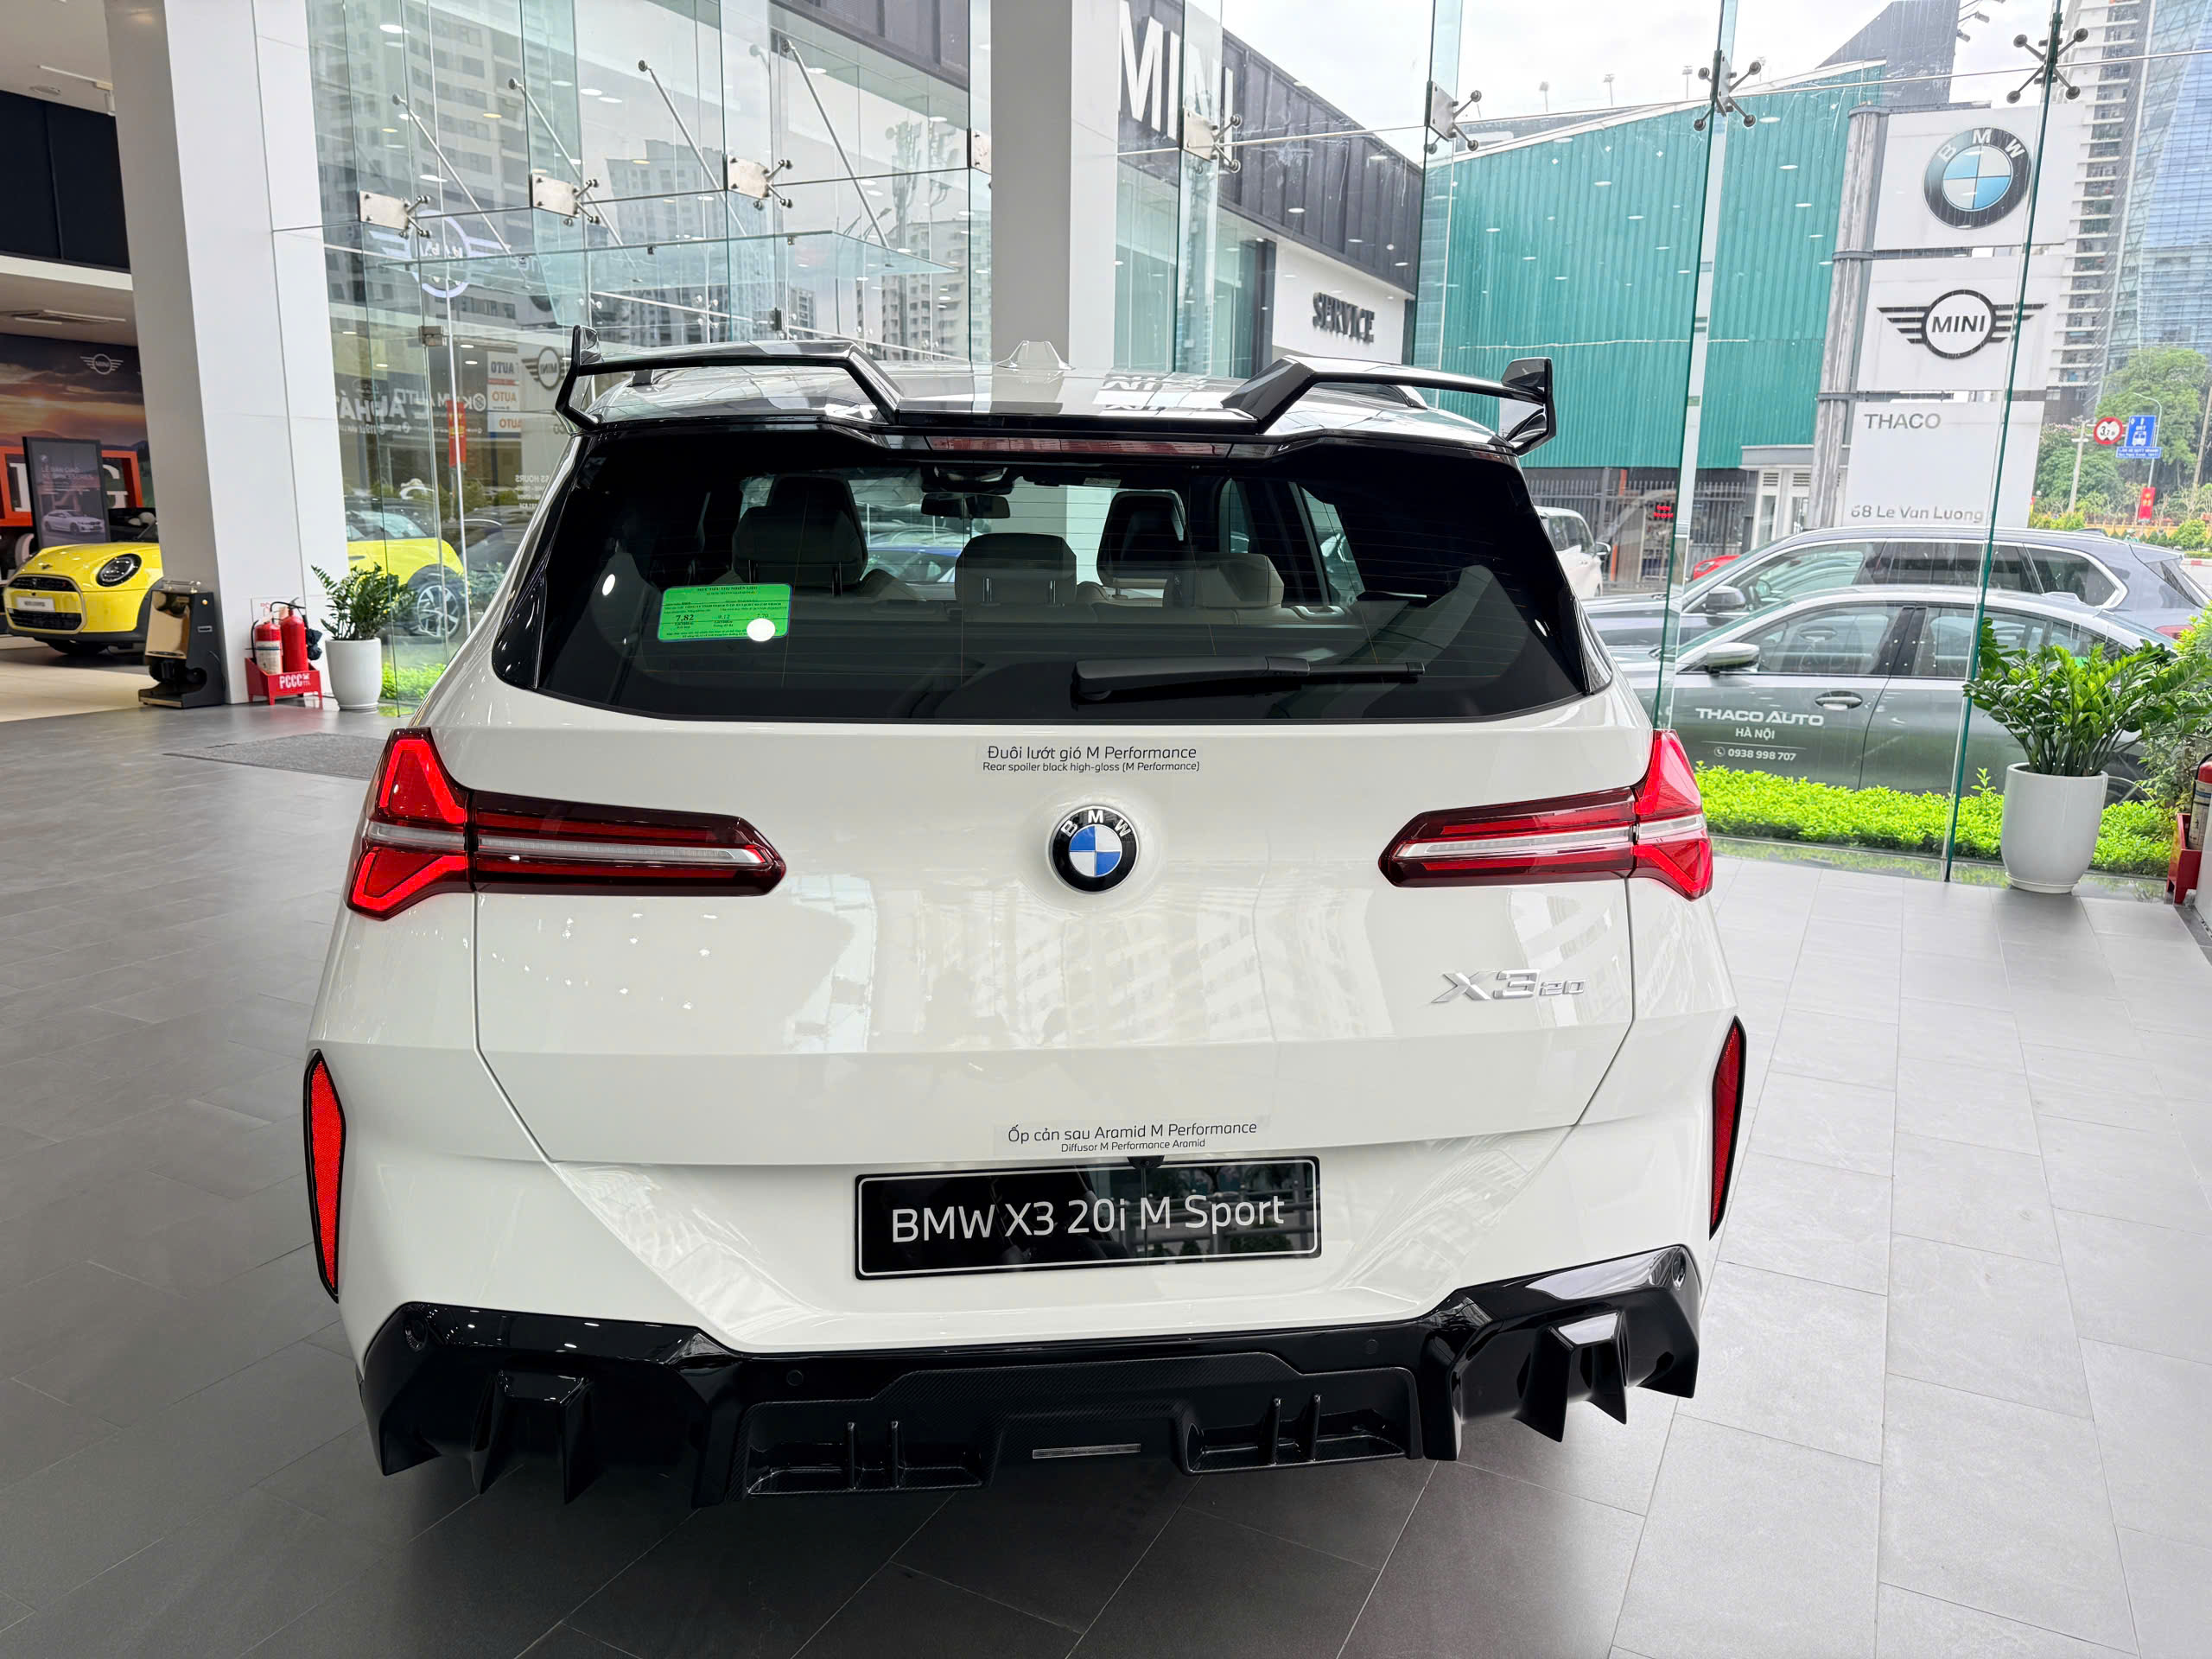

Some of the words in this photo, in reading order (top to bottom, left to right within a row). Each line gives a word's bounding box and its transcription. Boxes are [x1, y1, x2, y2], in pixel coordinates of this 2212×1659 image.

[1118, 0, 1234, 165] MINI
[1937, 129, 2026, 162] BMW
[1313, 292, 1375, 342] SERVICE
[1931, 315, 1986, 333] MINI
[1864, 413, 1942, 429] THACO
[1851, 505, 1872, 518] 68
[1877, 505, 1895, 518] Le
[1899, 505, 1929, 519] Van
[1933, 506, 1983, 524] Luong
[279, 675, 302, 690] PCCC
[1695, 708, 1764, 723] THACO
[1765, 710, 1824, 727] AUTO
[1735, 727, 1752, 738] HÀ
[1755, 728, 1776, 741] NỘI
[988, 746, 1022, 759] Đuôi
[1027, 747, 1056, 759] lướt
[1059, 747, 1081, 761] gió
[1086, 747, 1099, 759] M
[1105, 747, 1197, 759] Performance
[1728, 748, 1754, 759] 0938
[1756, 750, 1776, 760] 998
[1777, 752, 1796, 761] 707
[982, 762, 1006, 771] Rear
[1008, 763, 1040, 772] spoiler
[1071, 763, 1120, 772] high-gloss
[1122, 762, 1134, 772] (M
[1137, 761, 1200, 772] Performance)
[1060, 810, 1131, 837] BMW
[1431, 968, 1541, 1003] X3
[1008, 1124, 1029, 1144] Ốp
[1034, 1128, 1059, 1141] cản
[1065, 1129, 1090, 1140] sau
[1095, 1125, 1146, 1139] Aramid
[1151, 1124, 1163, 1137] M
[1168, 1122, 1257, 1136] Performance
[1061, 1142, 1097, 1152] Diffusor
[1100, 1141, 1109, 1150] M
[1111, 1140, 1170, 1150] Performance
[1173, 1138, 1205, 1148] Aramid
[892, 1205, 996, 1243] BMW
[1004, 1202, 1055, 1236] X3
[1067, 1197, 1126, 1233] 20i
[1140, 1197, 1172, 1230] M
[1185, 1194, 1286, 1234] Sport
